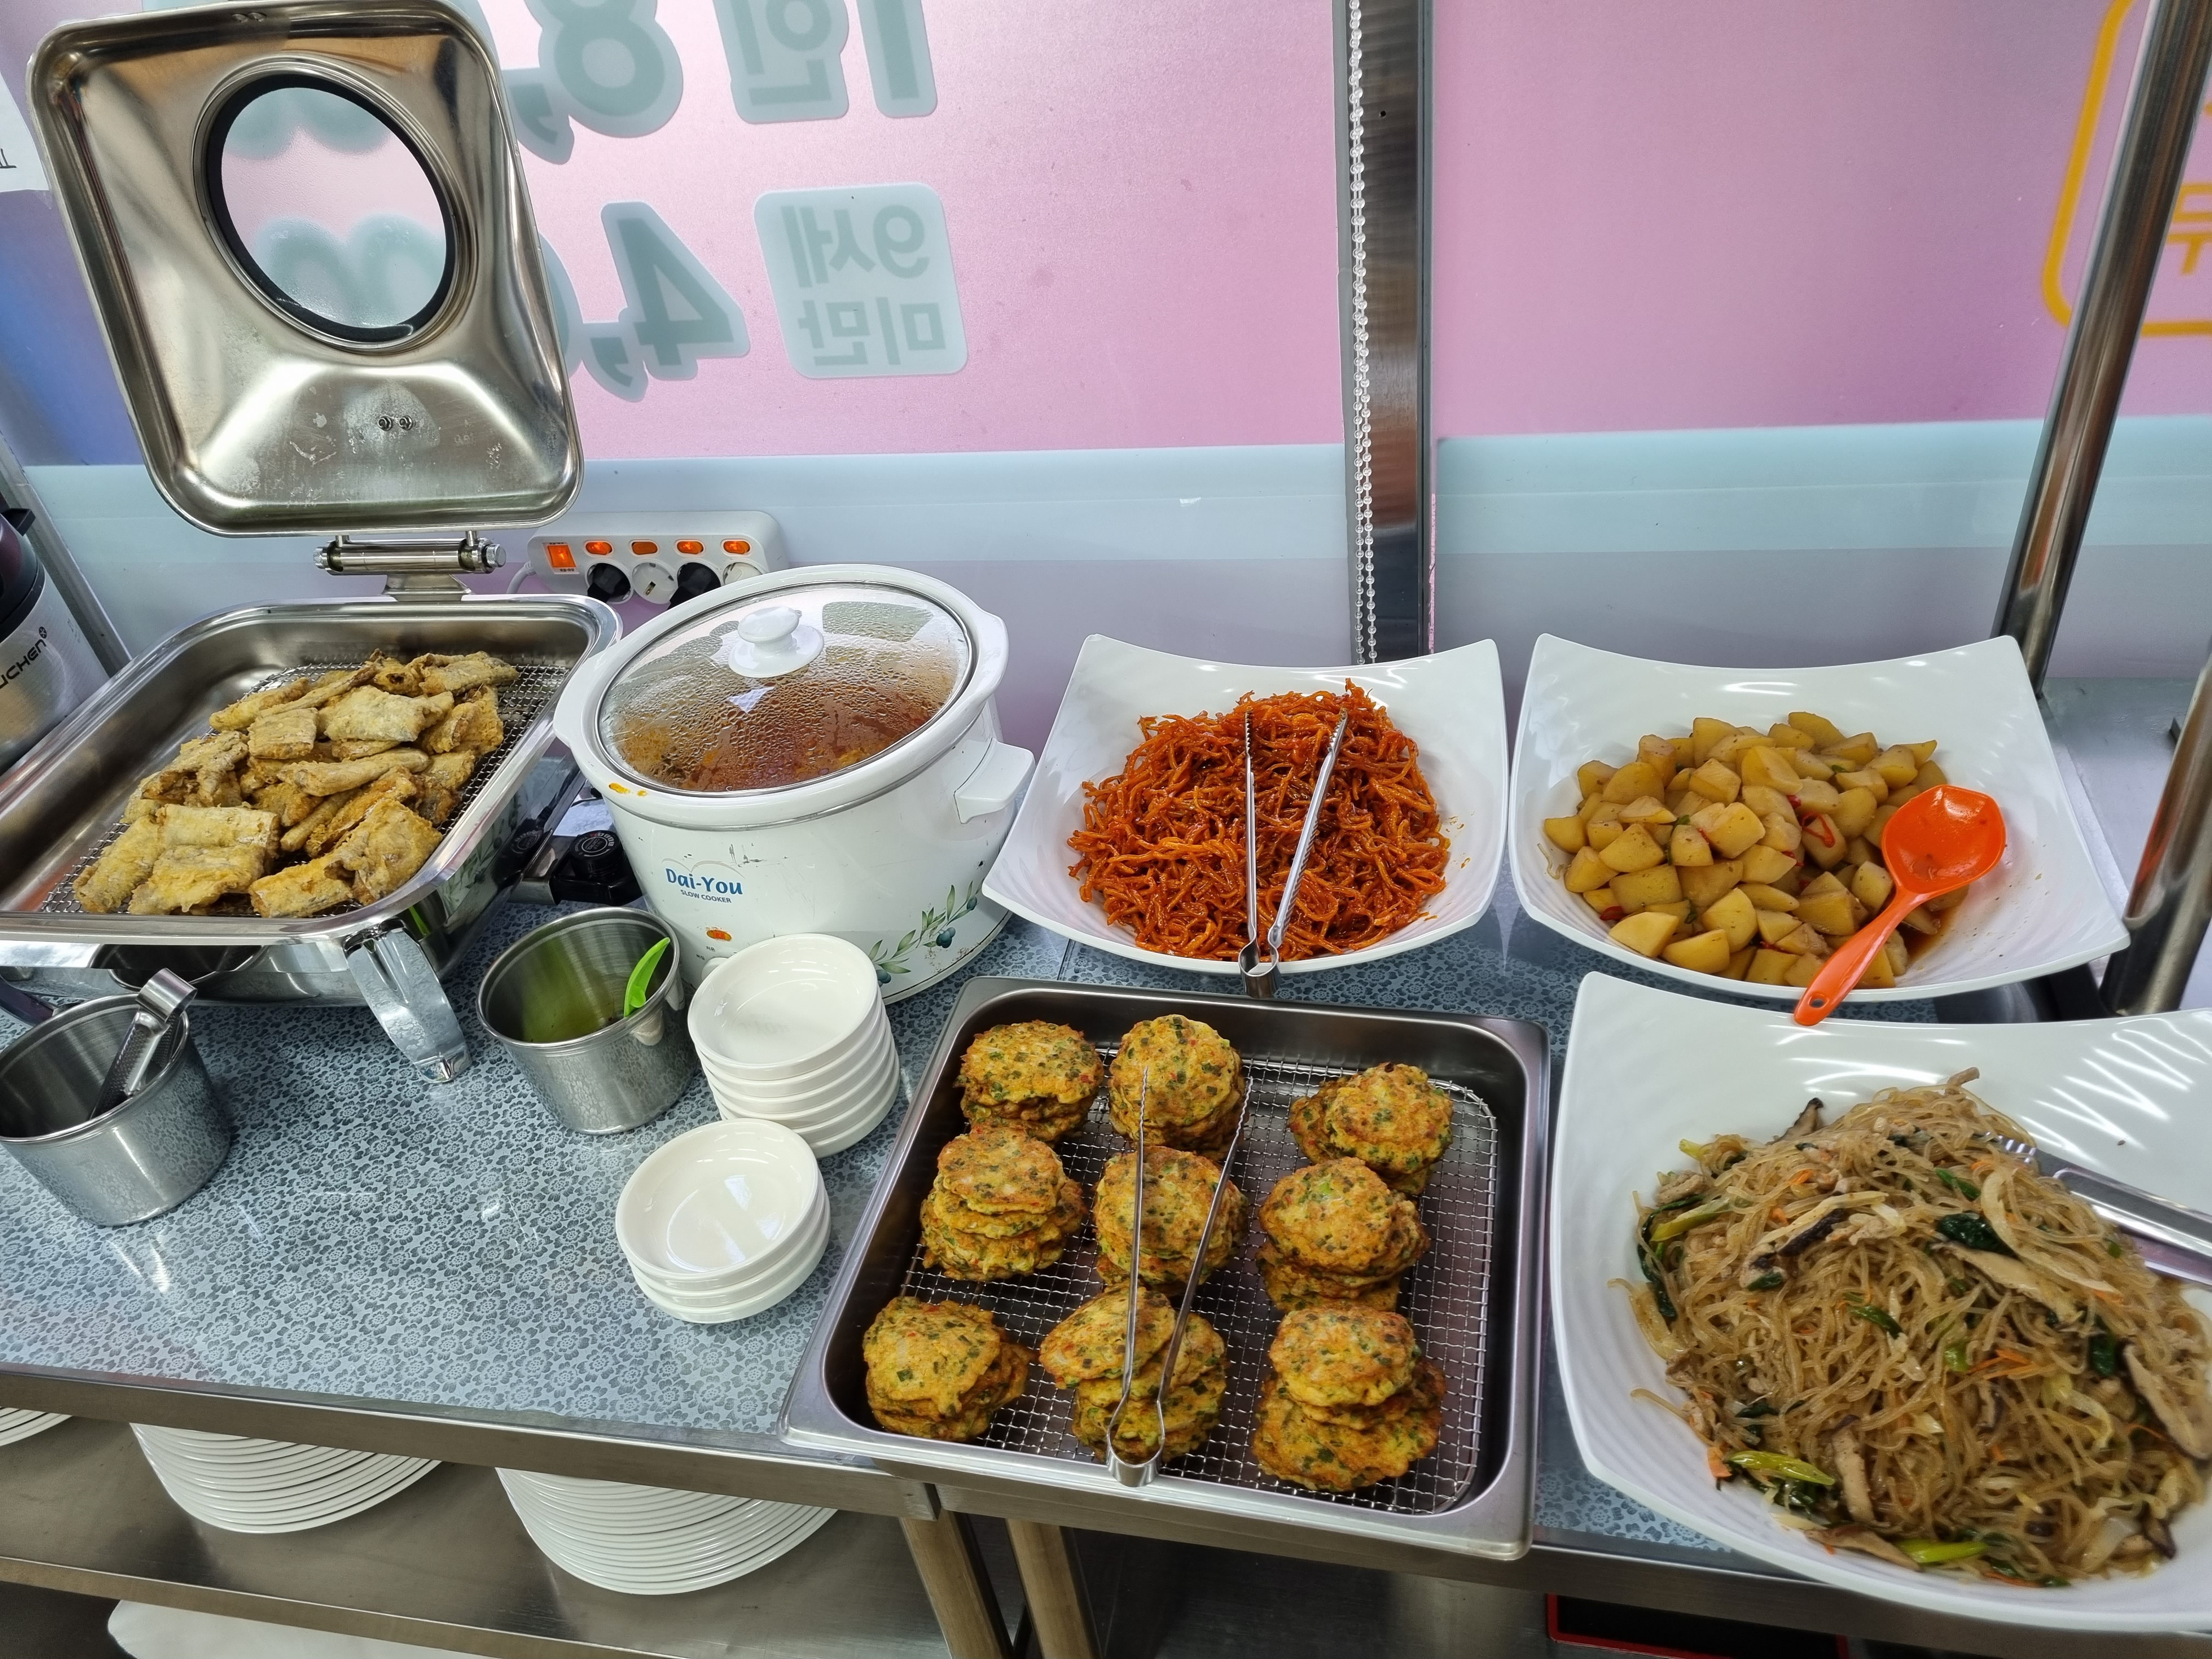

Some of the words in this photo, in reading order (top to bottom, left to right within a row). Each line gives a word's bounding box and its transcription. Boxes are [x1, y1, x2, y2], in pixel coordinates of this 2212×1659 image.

[665, 868, 743, 895] Dai-You
[680, 889, 699, 899] SLOW
[701, 894, 732, 904] COOKER
